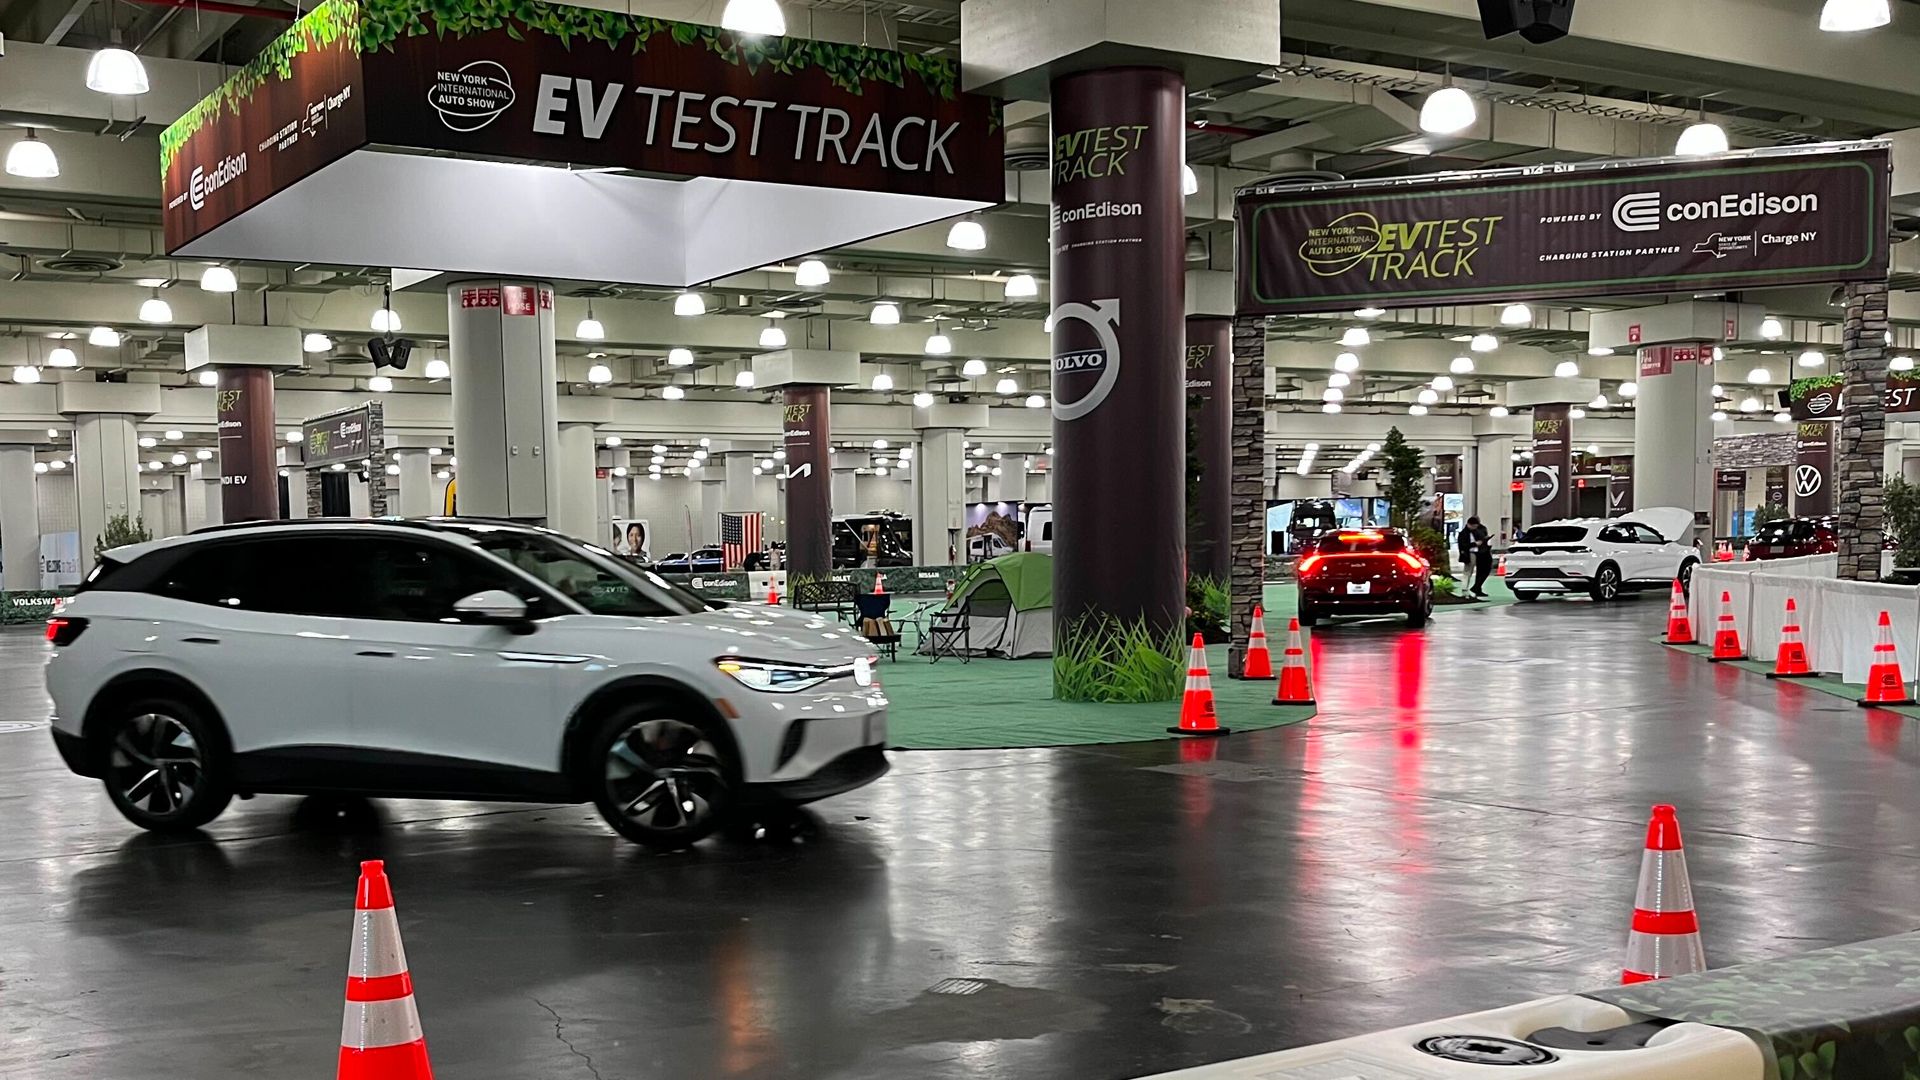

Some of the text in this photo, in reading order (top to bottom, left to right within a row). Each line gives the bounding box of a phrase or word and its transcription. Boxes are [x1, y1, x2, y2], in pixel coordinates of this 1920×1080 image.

[437, 71, 488, 86] NEW YORK
[327, 84, 351, 111] Charge NY
[438, 83, 510, 100] INTERNATIONAL
[438, 94, 495, 109] AUTO SHOW
[532, 73, 960, 174] EV TEST TRACK
[259, 120, 298, 153] CHARGING STATION
[278, 132, 298, 152] PARTNER
[204, 152, 247, 195] conEdison
[1062, 201, 1142, 223] conEdison
[1666, 192, 1818, 221] conEdison
[1540, 214, 1586, 224] POWERED
[1308, 227, 1355, 237] NEW YORK
[1308, 234, 1376, 246] INTERNATIONAL
[1761, 231, 1817, 245] Charge NY
[1308, 245, 1362, 256] AUTO SHOW
[1539, 246, 1680, 261] CHARGING STATION PARTNER
[1365, 248, 1479, 281] TRACK
[1884, 387, 1917, 407] EST
[234, 475, 247, 484] EV
